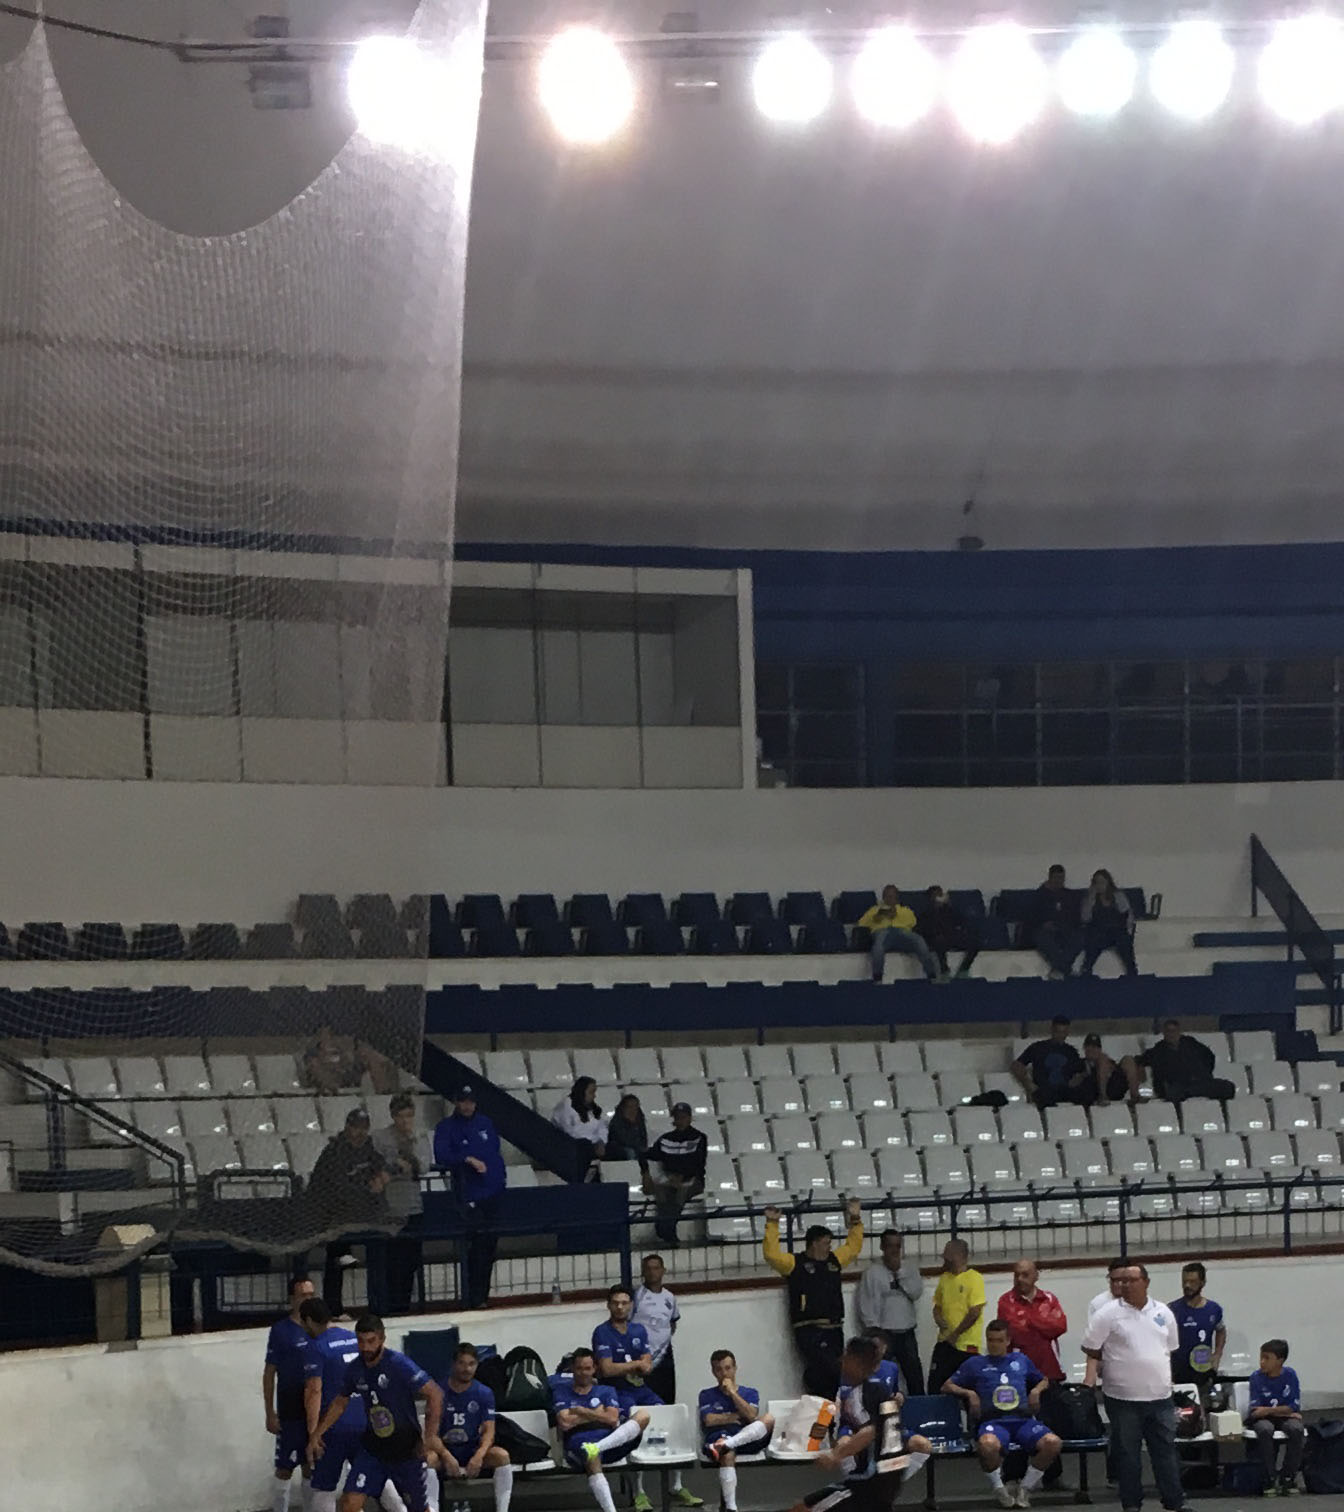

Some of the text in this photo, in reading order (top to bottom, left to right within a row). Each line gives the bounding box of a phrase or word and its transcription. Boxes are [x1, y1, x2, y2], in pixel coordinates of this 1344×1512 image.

[1198, 1329, 1207, 1342] 9
[999, 1372, 1009, 1384] 6
[370, 1391, 379, 1405] 3
[452, 1412, 466, 1426] 15
